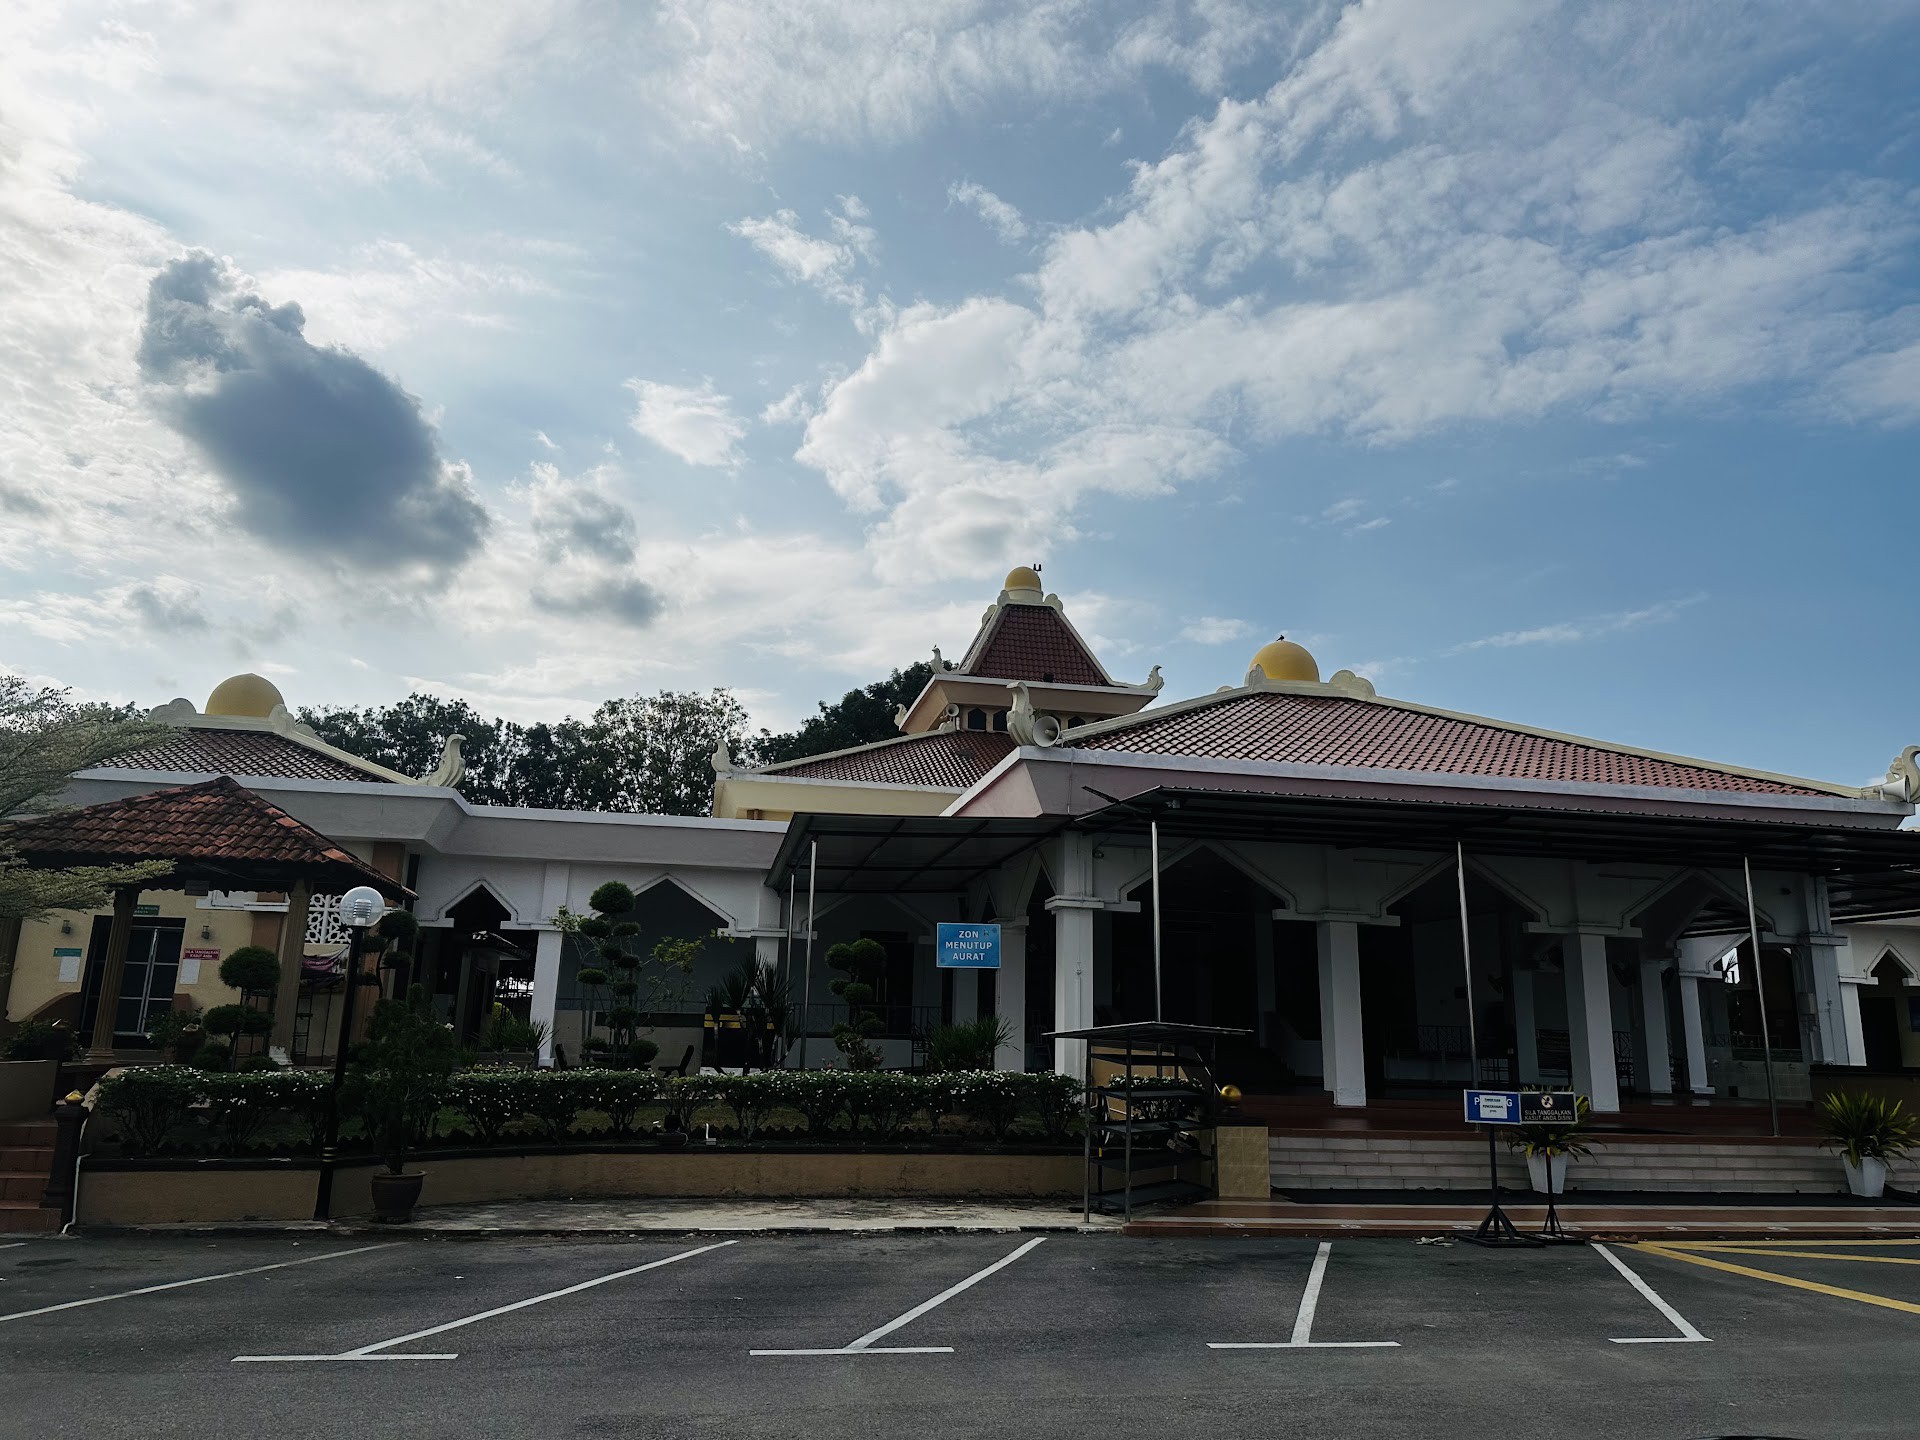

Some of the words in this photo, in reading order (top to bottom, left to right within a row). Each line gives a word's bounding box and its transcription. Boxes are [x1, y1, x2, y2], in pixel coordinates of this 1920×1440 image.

[958, 930, 979, 939] ZON
[945, 941, 993, 950] MENUTUP
[952, 952, 985, 961] AURAT
